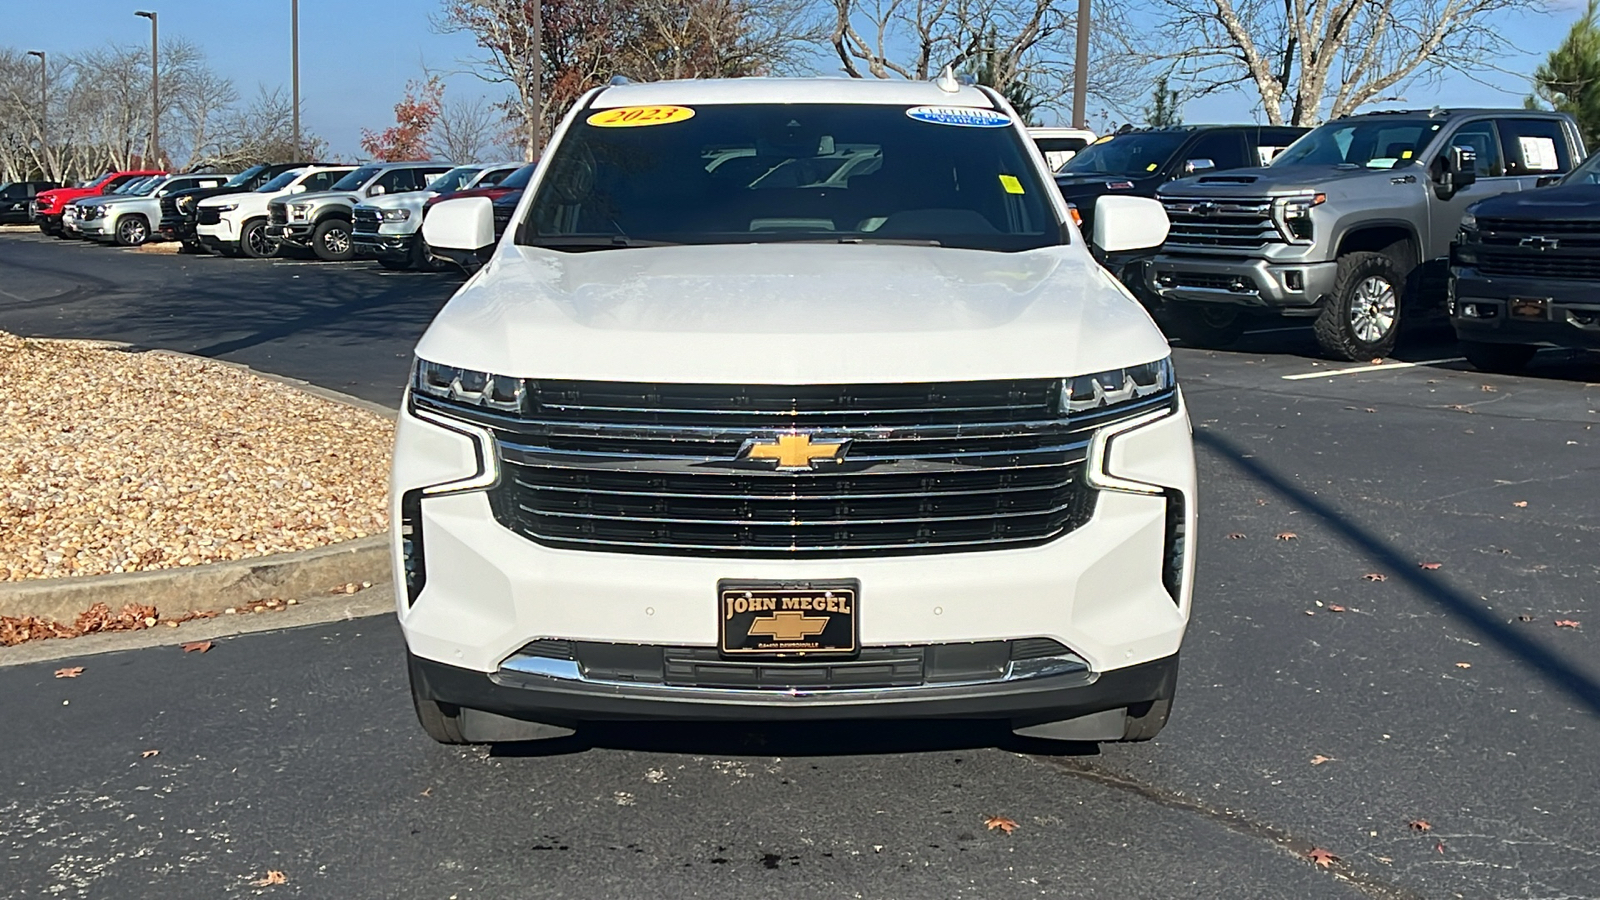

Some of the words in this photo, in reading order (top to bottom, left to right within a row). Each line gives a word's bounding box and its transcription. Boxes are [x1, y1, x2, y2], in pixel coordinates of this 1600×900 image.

[602, 108, 679, 123] 2023
[918, 107, 998, 118] CERTIFIED
[726, 597, 777, 620] JOHN
[781, 597, 851, 614] MEGEL
